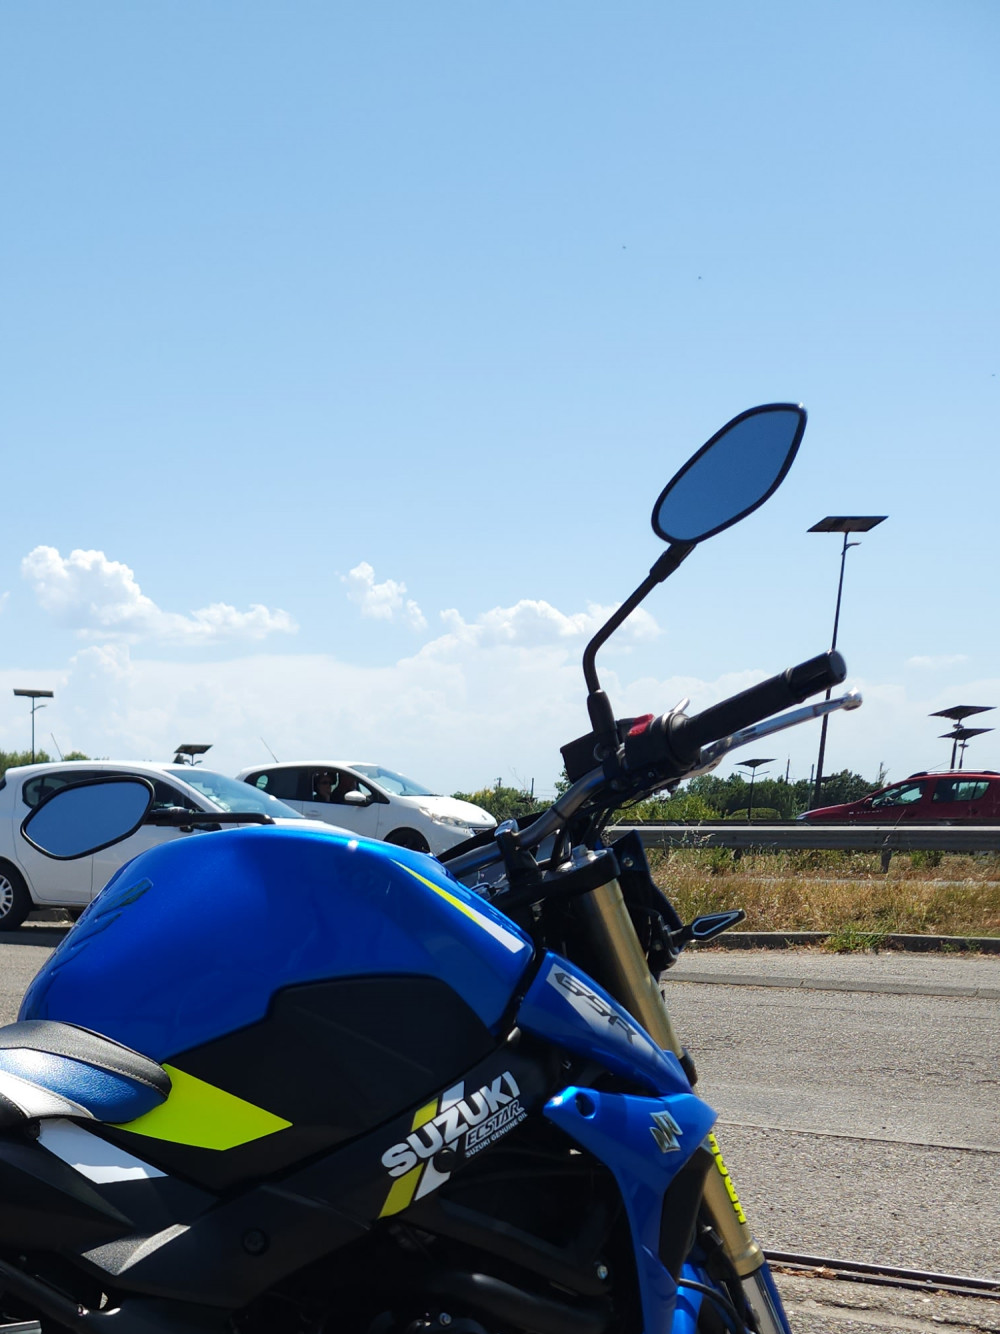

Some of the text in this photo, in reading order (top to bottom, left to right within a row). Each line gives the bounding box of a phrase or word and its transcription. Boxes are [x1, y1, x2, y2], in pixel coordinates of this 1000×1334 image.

[381, 1071, 520, 1177] SUZUKI
[465, 1099, 525, 1151] ECSTAR
[465, 1112, 528, 1158] SUZUKI GENUINE OIL
